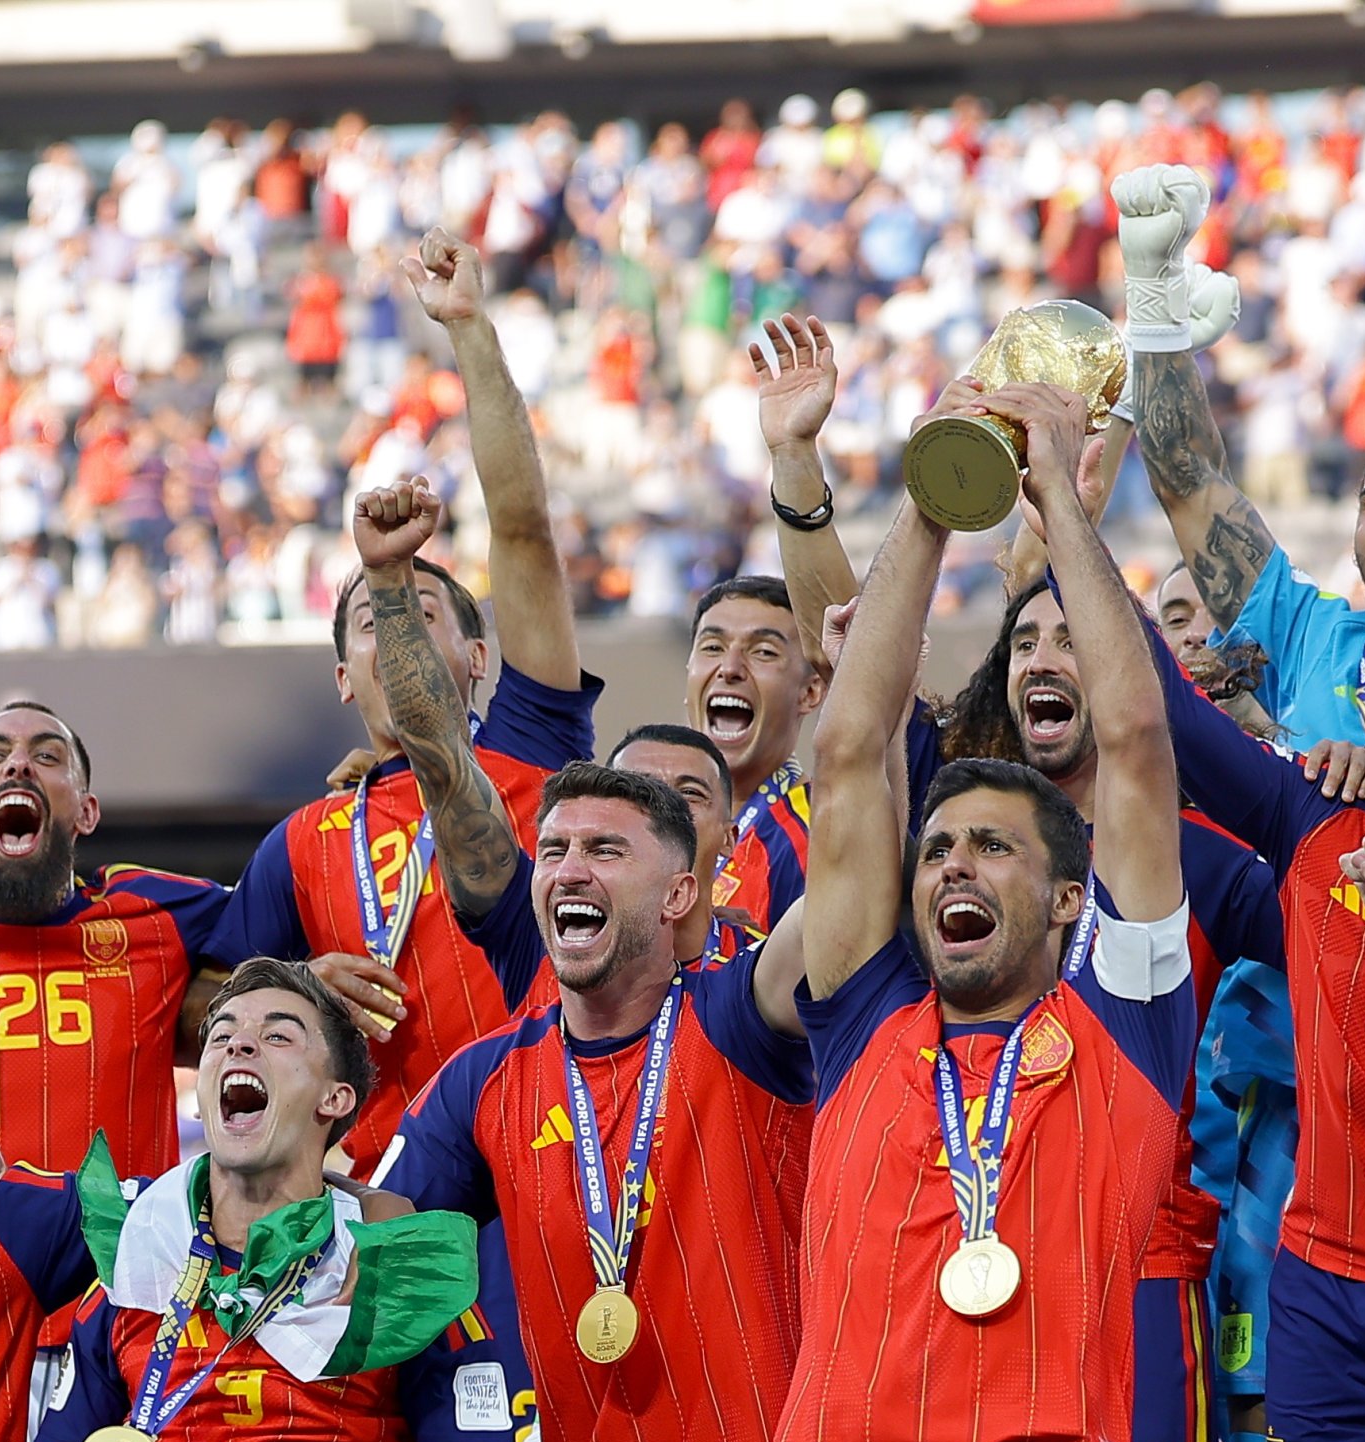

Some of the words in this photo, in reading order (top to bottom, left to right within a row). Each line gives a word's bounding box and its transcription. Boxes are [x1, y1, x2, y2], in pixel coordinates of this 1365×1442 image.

[355, 843, 368, 874] WORLD
[360, 875, 372, 899] CUP
[363, 900, 377, 932] 2026
[1068, 942, 1082, 973] FIFA
[1075, 896, 1096, 943] WORLD
[658, 995, 674, 1041] 2026
[652, 1042, 666, 1067] CUP
[941, 1071, 953, 1094] CUP
[996, 1064, 1012, 1087] CUP
[641, 1069, 660, 1121] WORLD
[988, 1087, 1006, 1128] 2026
[574, 1088, 592, 1137] WORLD
[943, 1093, 960, 1130] WORLD
[633, 1121, 647, 1151] FIFA
[948, 1129, 963, 1158] FIFA
[582, 1138, 596, 1165] CUP
[584, 1166, 603, 1215] 2026
[145, 1368, 162, 1395] FIFA
[464, 1373, 498, 1385] FOOTBALL
[465, 1385, 498, 1398] UNITES
[465, 1399, 478, 1410] the
[479, 1399, 500, 1411] World
